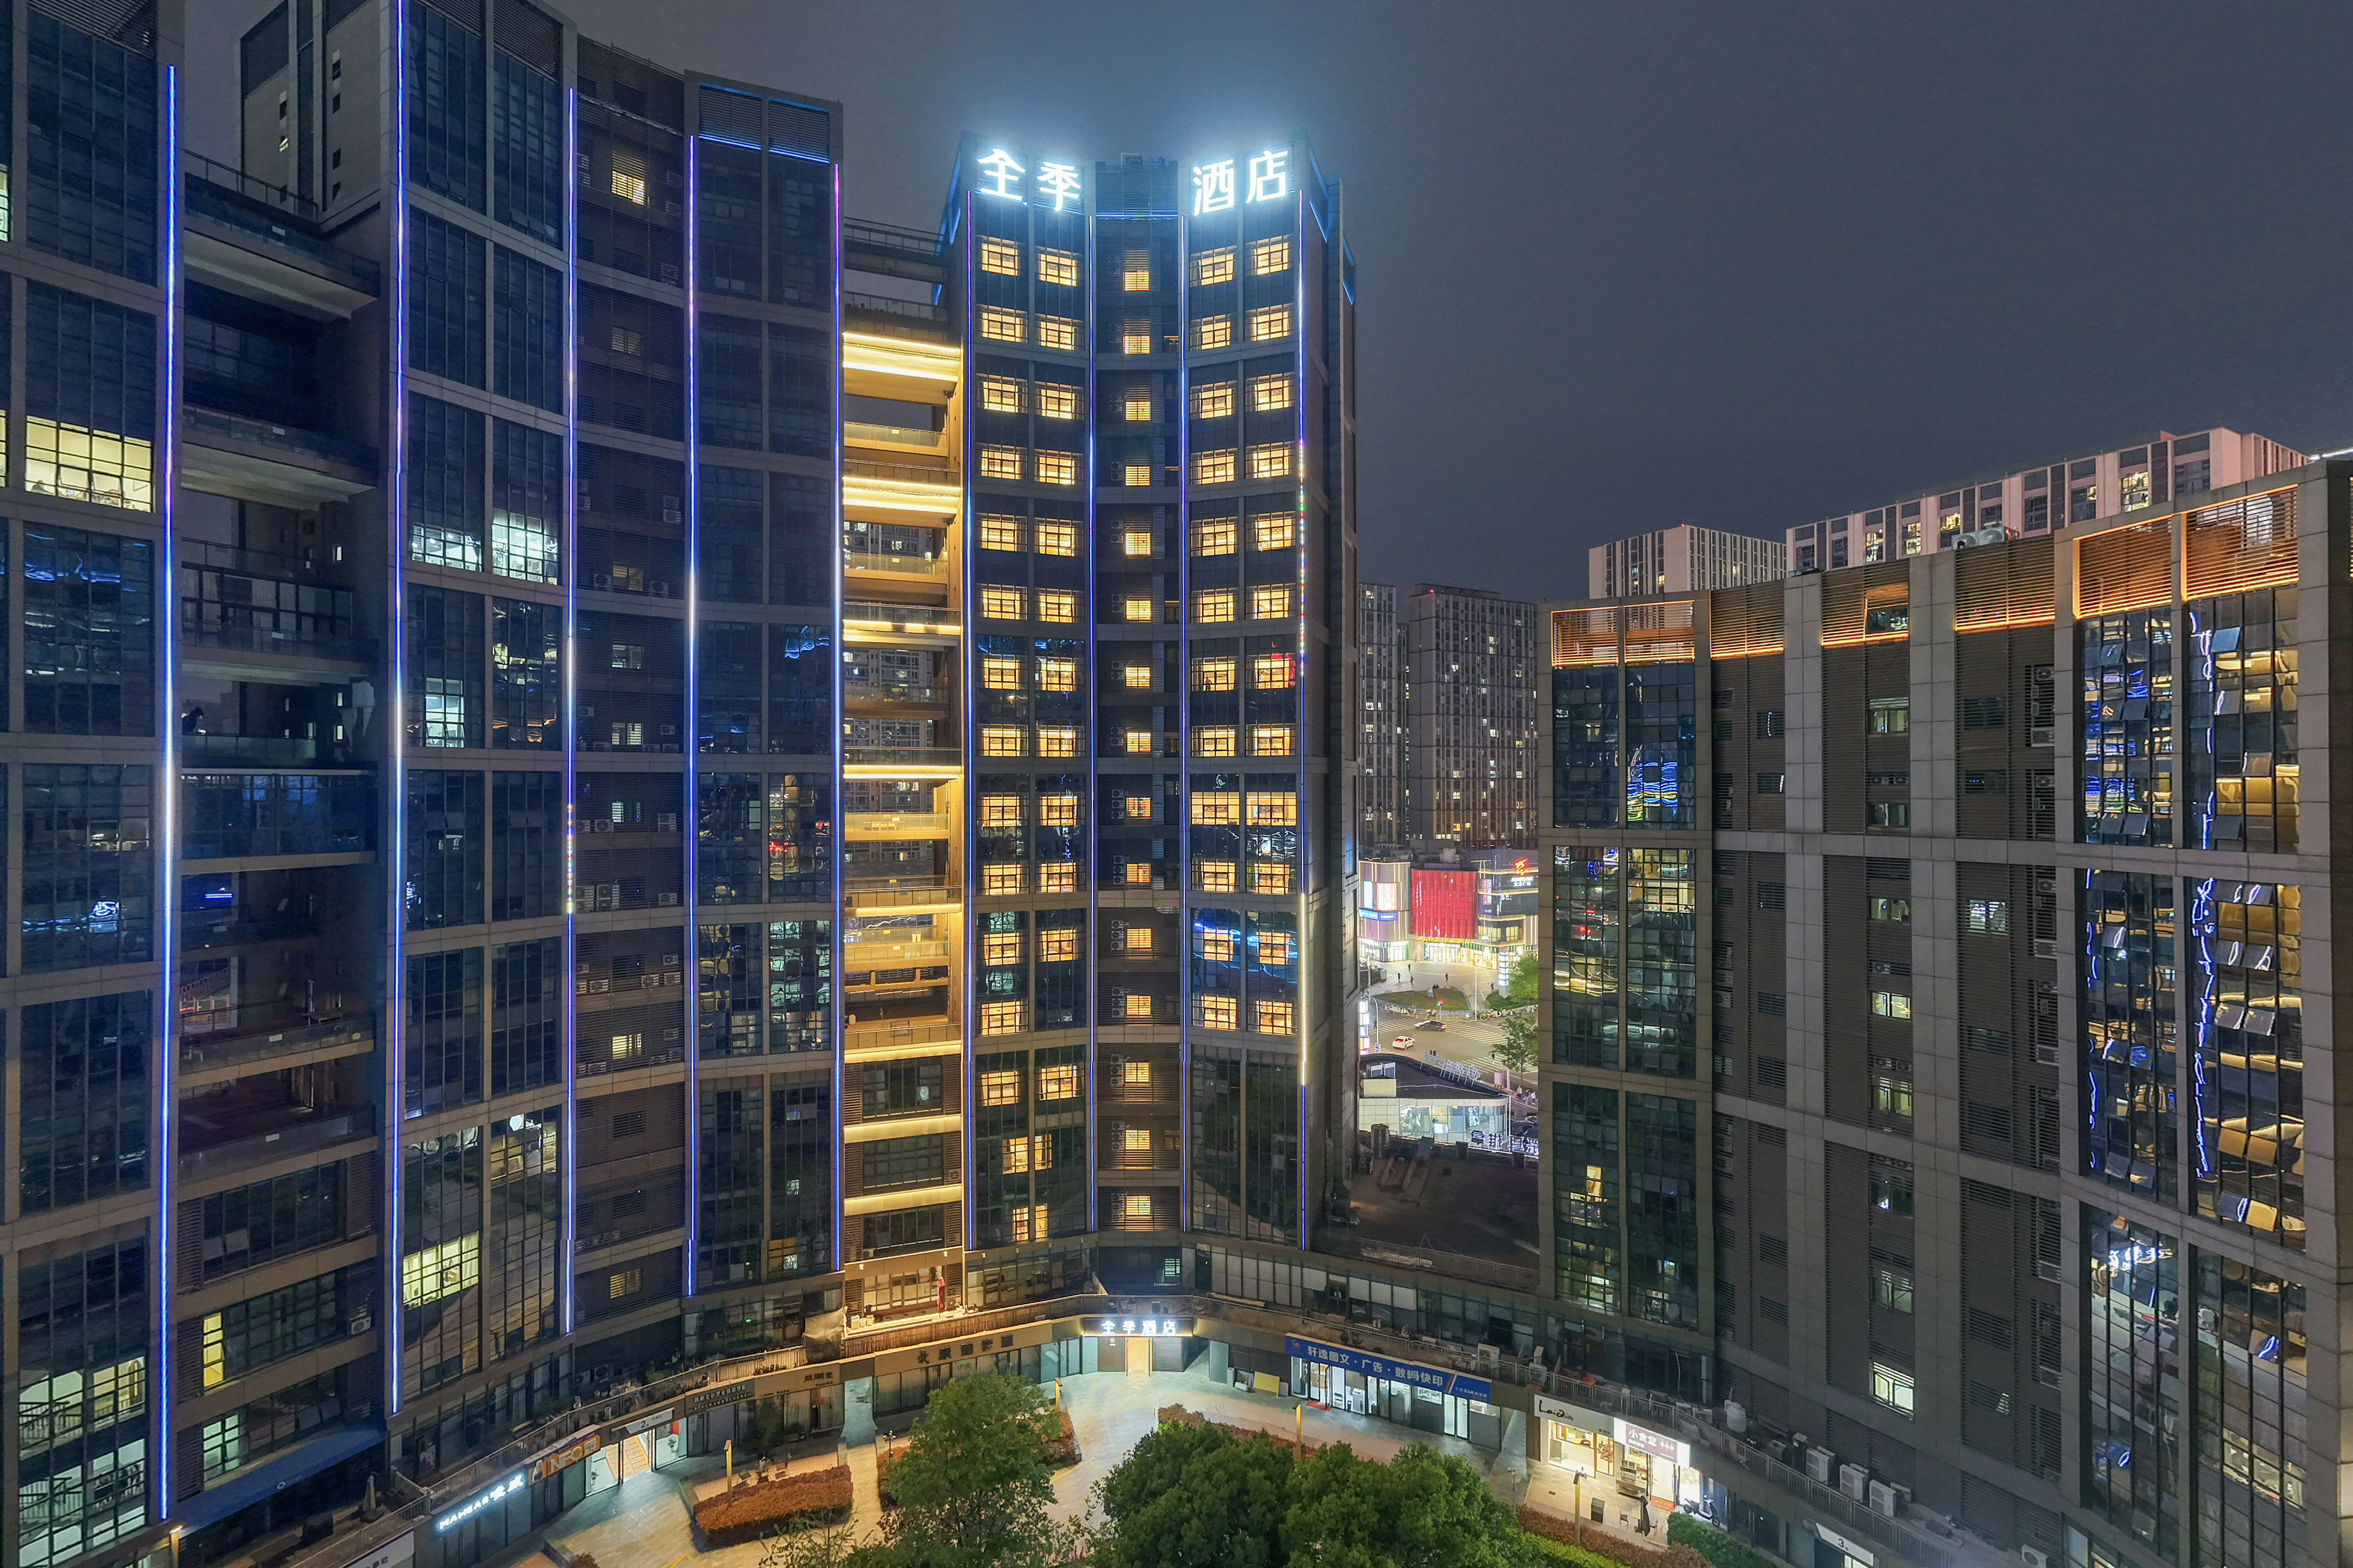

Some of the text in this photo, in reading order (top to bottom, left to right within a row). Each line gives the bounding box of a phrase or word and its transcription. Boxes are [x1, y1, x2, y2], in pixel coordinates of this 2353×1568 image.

[977, 148, 1288, 216] 全季 酒店
[1101, 1320, 1176, 1335] 全季酒店
[1628, 1429, 1657, 1447] 小食堂
